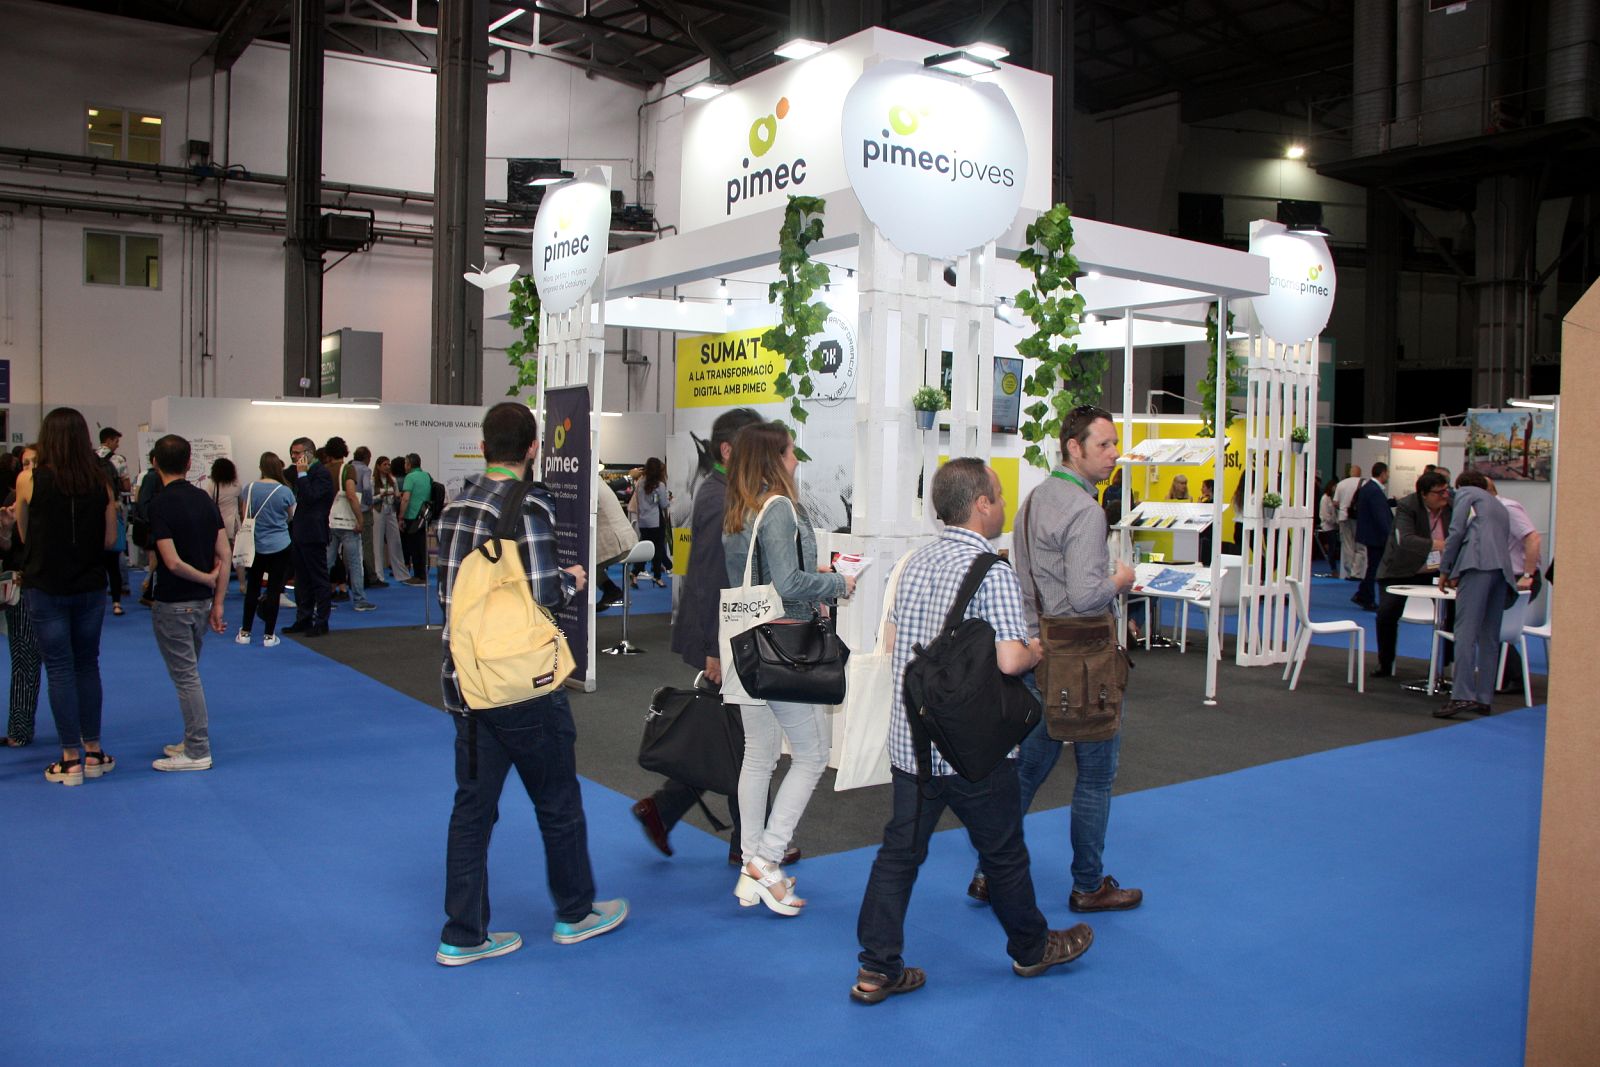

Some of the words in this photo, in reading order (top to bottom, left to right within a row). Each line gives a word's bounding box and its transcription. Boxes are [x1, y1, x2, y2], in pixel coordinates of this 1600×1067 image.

[863, 129, 1014, 187] pimecjoves
[727, 157, 806, 215] pimec
[544, 231, 589, 271] pimec
[700, 337, 761, 365] SUMA'T
[688, 372, 694, 382] A
[695, 371, 705, 381] LA
[706, 361, 774, 380] TRANSFORMACIÓ
[693, 386, 722, 397] DIGITAL
[723, 384, 741, 395] AMB
[742, 382, 767, 393] PIMEC
[420, 420, 453, 428] INNOHUB
[545, 447, 579, 478] pimec
